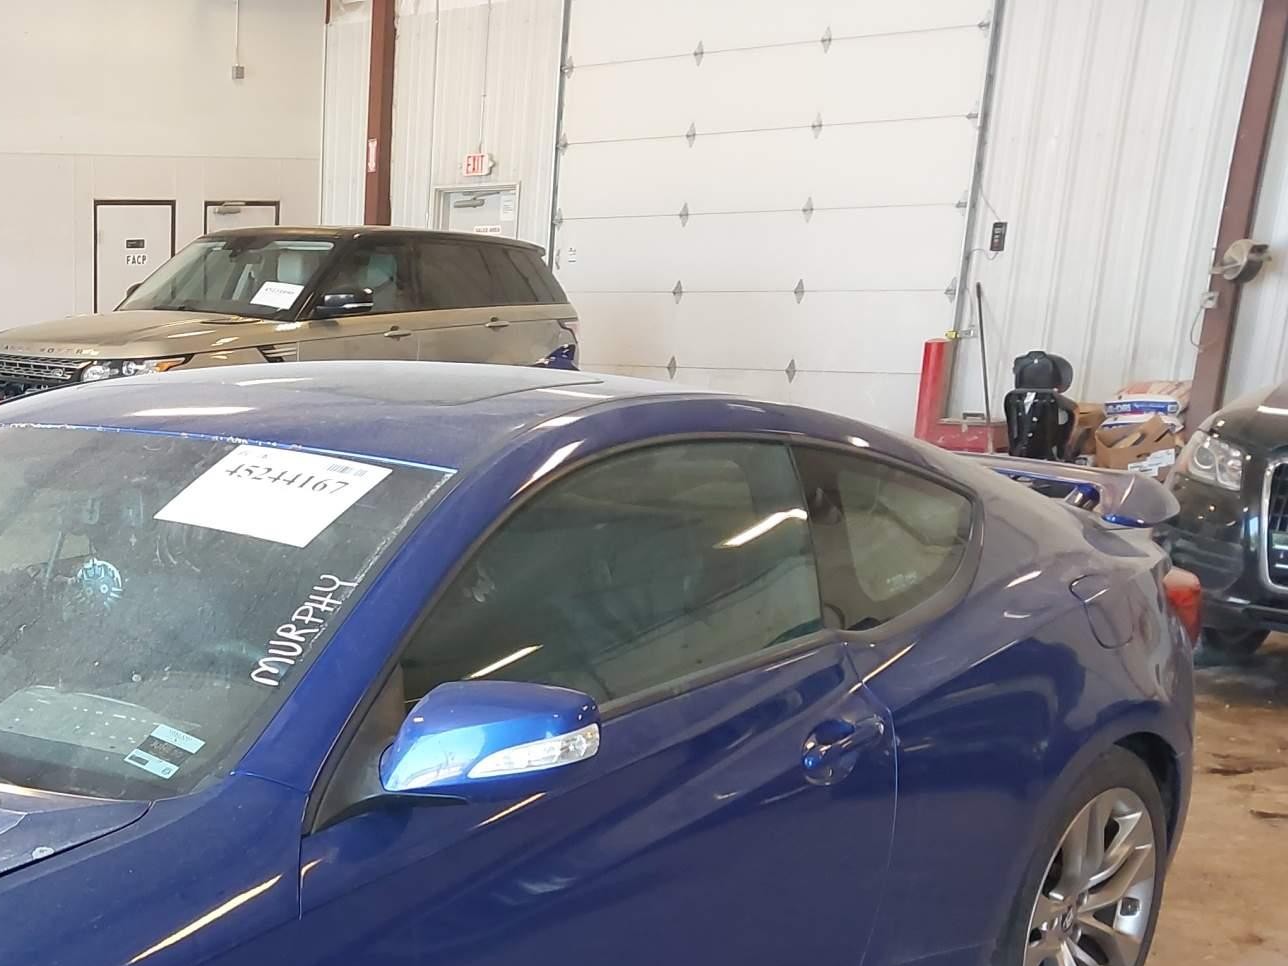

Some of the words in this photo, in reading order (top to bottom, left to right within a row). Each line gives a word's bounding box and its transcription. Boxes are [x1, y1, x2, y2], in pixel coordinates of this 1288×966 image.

[465, 155, 485, 174] EXIT
[126, 255, 147, 265] FACP
[225, 463, 350, 494] 45244167
[250, 573, 359, 687] MURPHY
